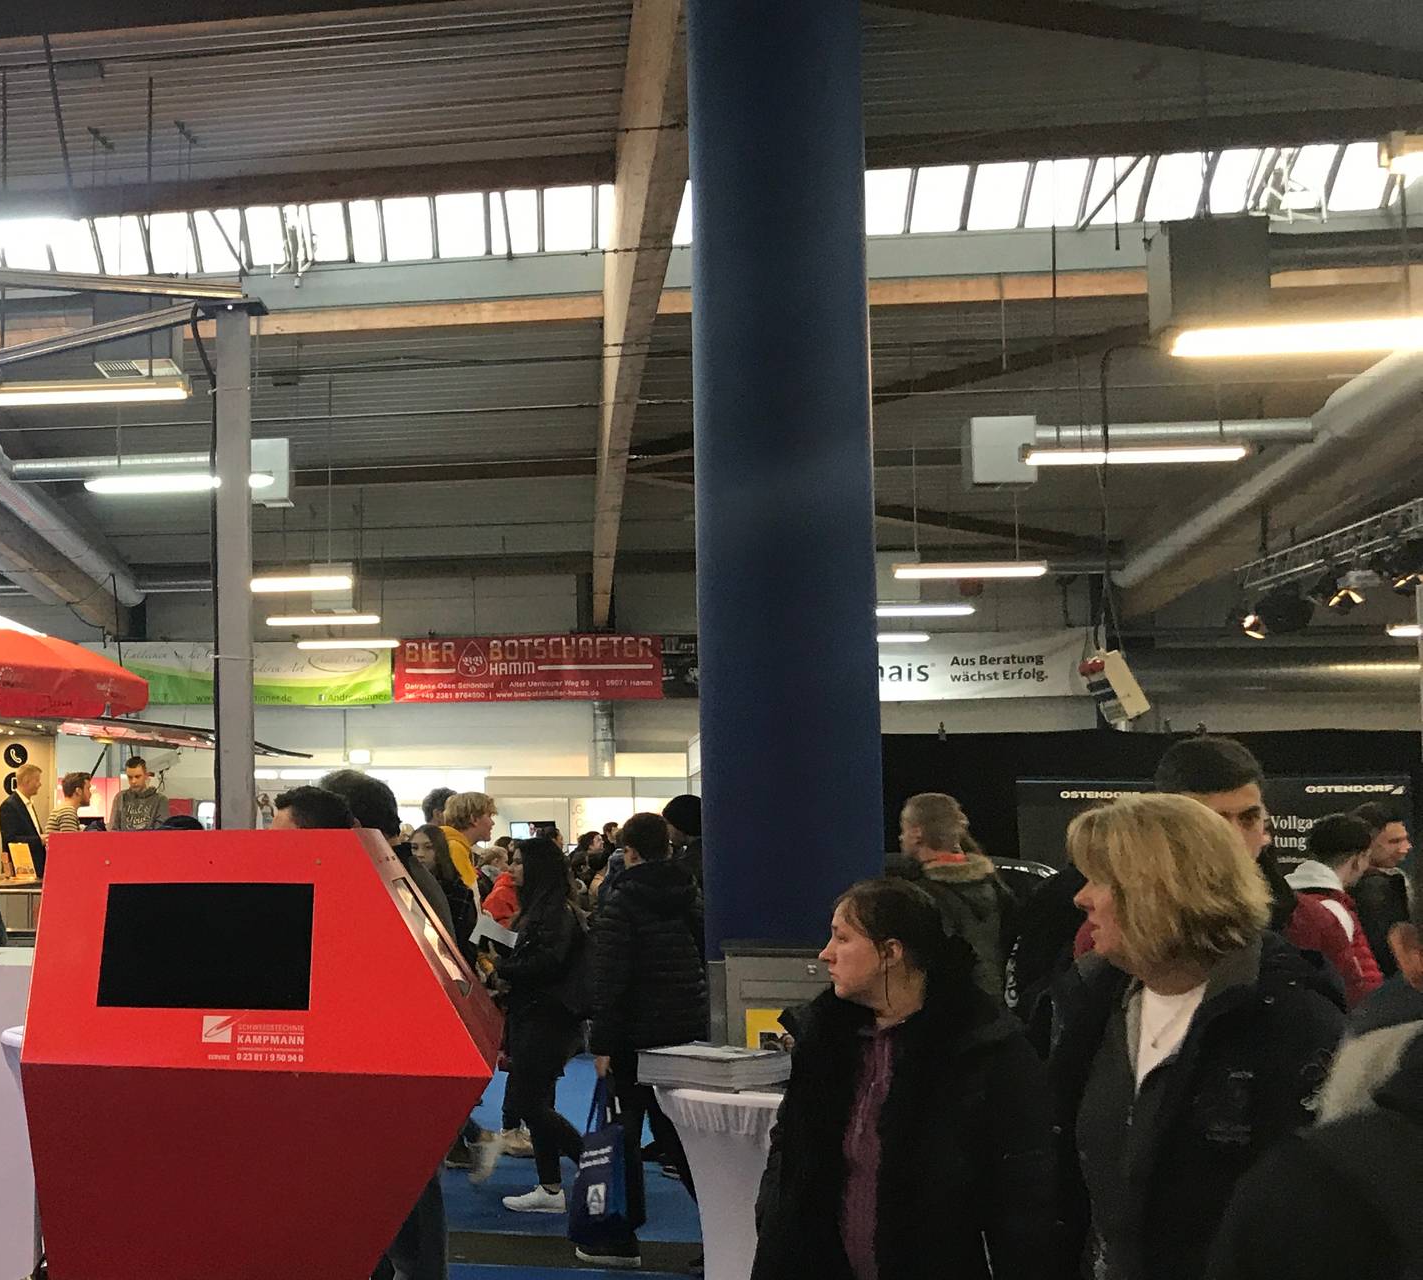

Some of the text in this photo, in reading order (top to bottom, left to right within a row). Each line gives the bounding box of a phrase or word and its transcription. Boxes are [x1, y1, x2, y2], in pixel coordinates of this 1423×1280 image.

[405, 641, 456, 662] BIER
[489, 636, 654, 661] BOTSCHAFTER
[950, 654, 1046, 666] Aus Beratung
[489, 661, 535, 676] HAMM
[950, 670, 1000, 682] wächst
[1304, 784, 1395, 794] OSTENDORF
[236, 1034, 305, 1046] KAMPMANN
